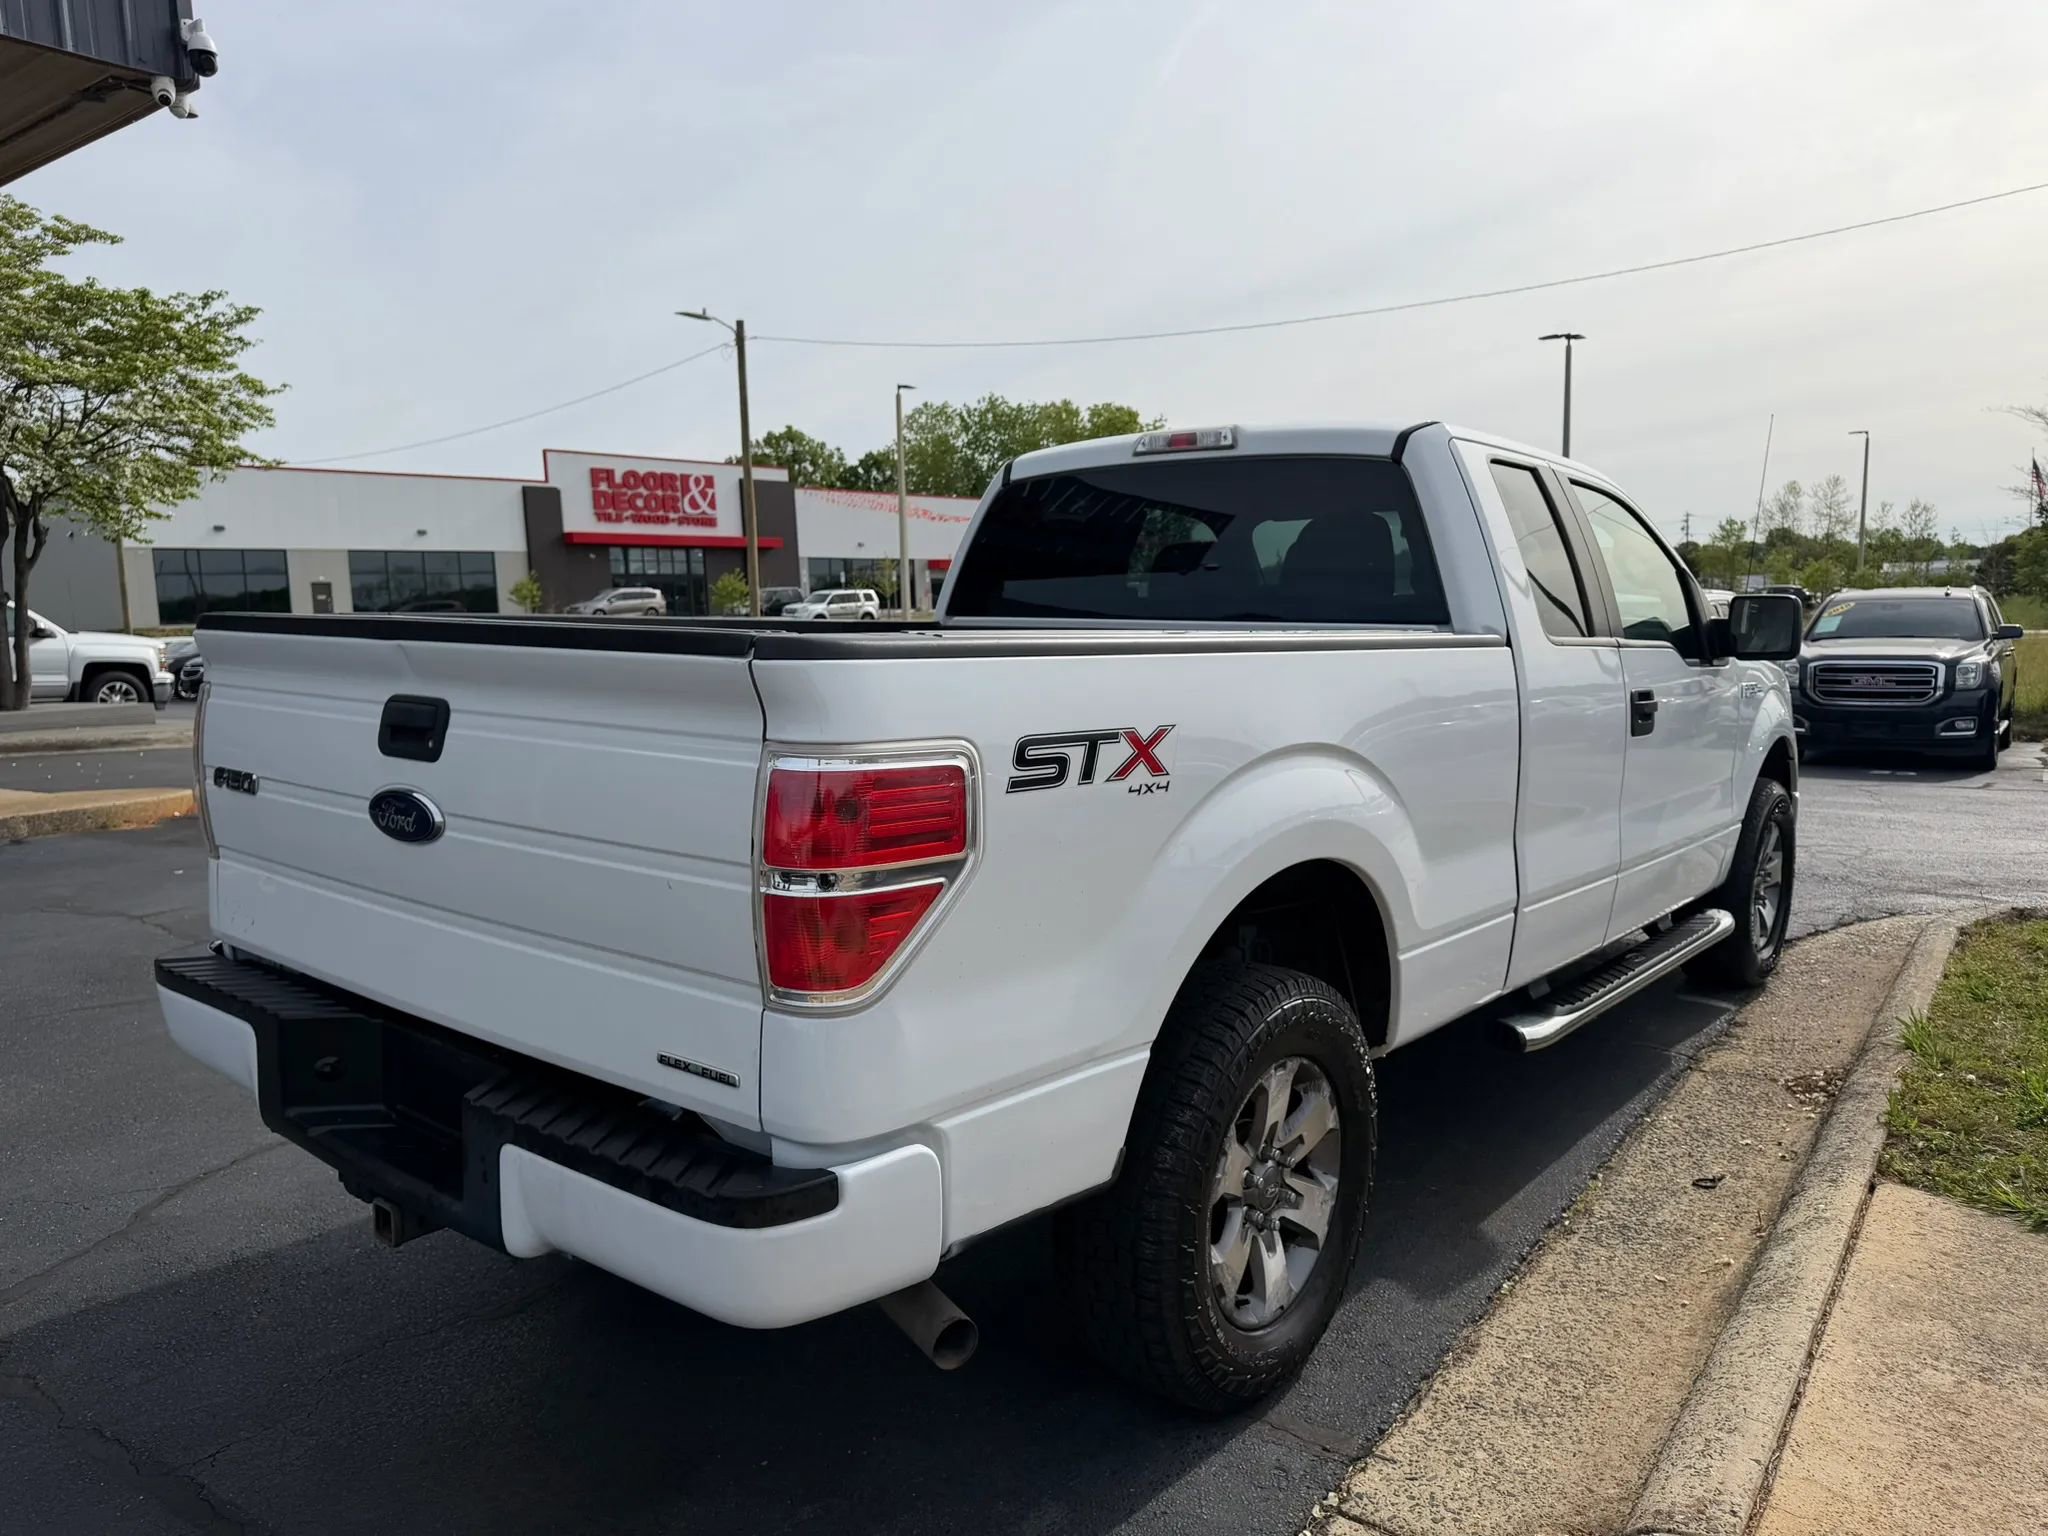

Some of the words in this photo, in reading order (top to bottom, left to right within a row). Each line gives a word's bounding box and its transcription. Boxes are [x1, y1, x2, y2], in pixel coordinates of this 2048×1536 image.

[590, 468, 679, 492] FLOOR
[683, 474, 717, 515] &
[592, 490, 681, 513] DECOR
[1851, 676, 1896, 688] GMC
[1005, 724, 1176, 794] STX
[376, 798, 417, 833] Ford
